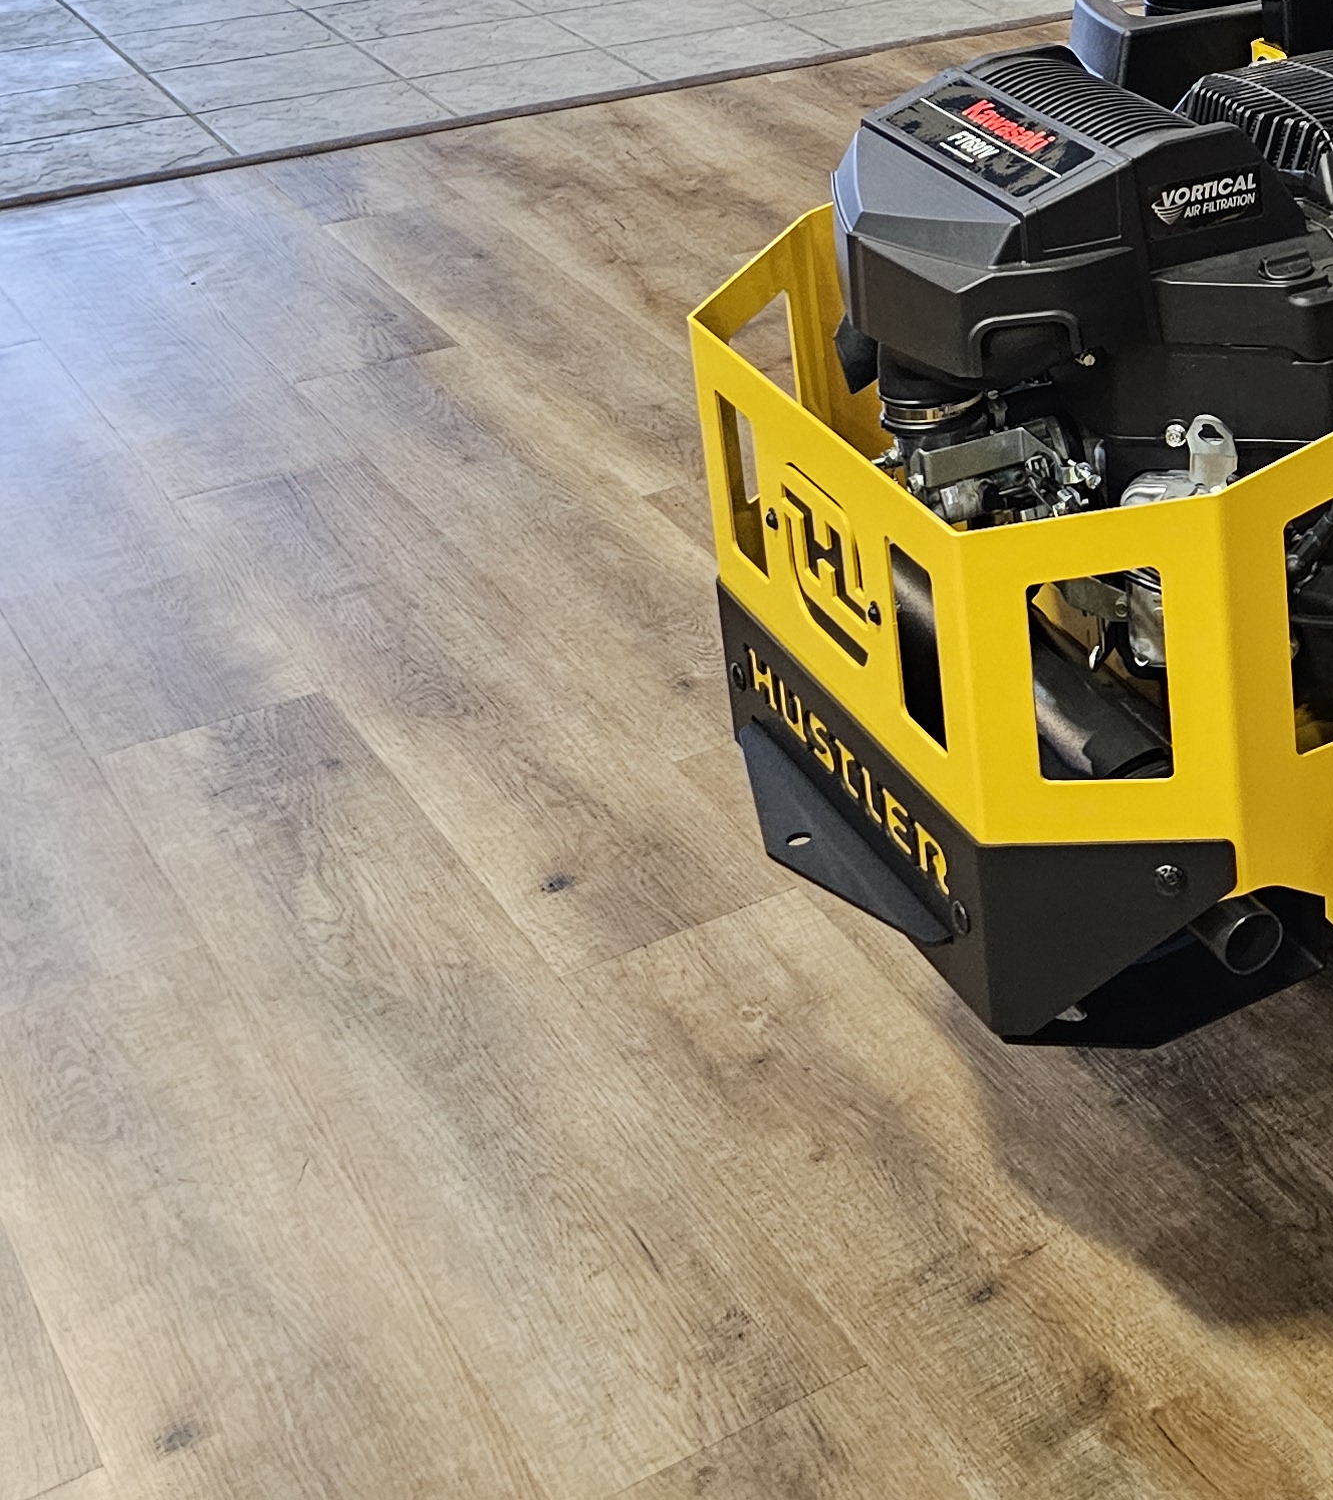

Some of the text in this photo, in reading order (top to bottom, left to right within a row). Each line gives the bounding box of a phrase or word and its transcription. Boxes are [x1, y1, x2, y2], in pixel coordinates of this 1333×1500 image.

[961, 99, 1057, 154] Kawasaki
[1161, 173, 1257, 208] VORTICAL
[1183, 192, 1256, 219] AIR FILTRATION
[748, 646, 950, 897] HUSTLER
